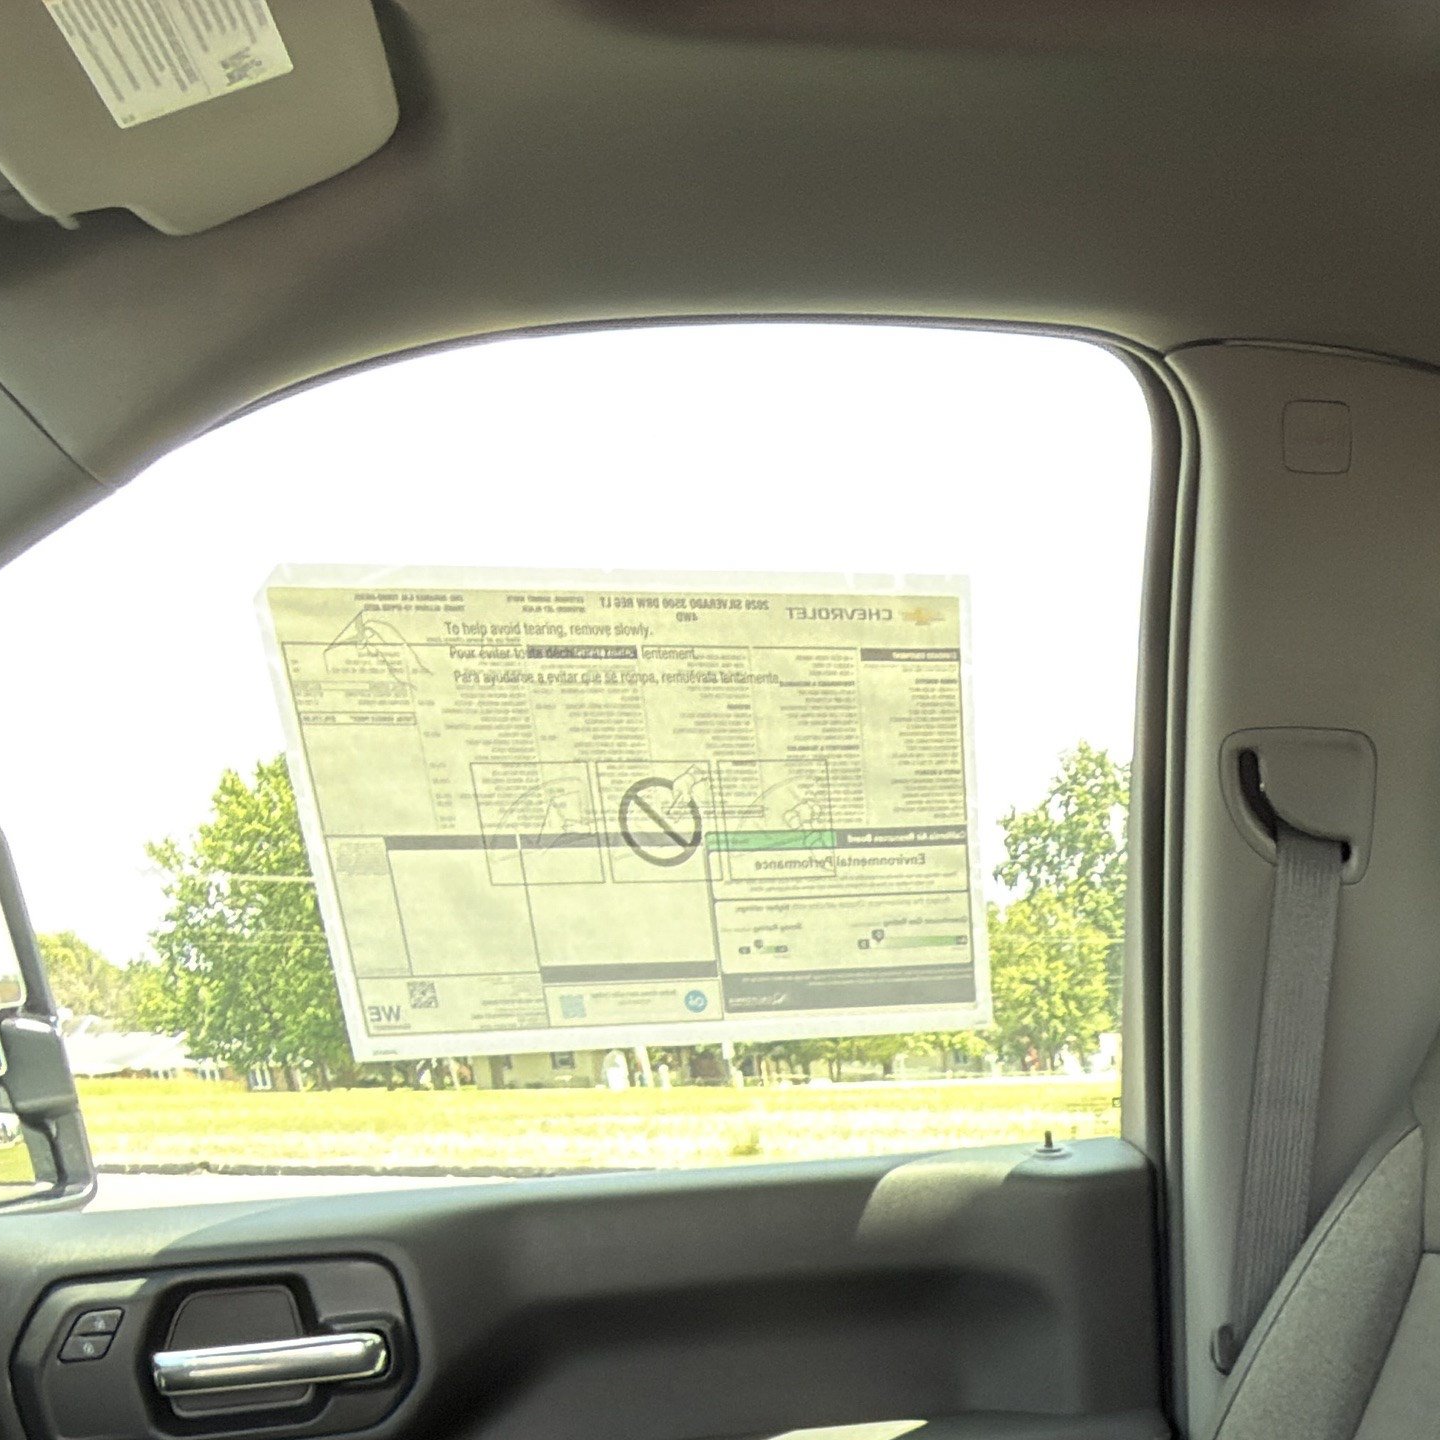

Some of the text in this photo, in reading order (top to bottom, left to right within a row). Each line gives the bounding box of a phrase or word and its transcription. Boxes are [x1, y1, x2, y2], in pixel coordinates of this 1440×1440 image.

[444, 622, 653, 638] To help avoid tearing, remove slowly.
[449, 647, 475, 658] Pour
[454, 671, 479, 682] Para
[483, 671, 533, 685] ayudarse
[537, 674, 544, 682] a
[547, 672, 578, 683] evitar
[581, 674, 601, 685] que
[622, 673, 658, 684] rompa,
